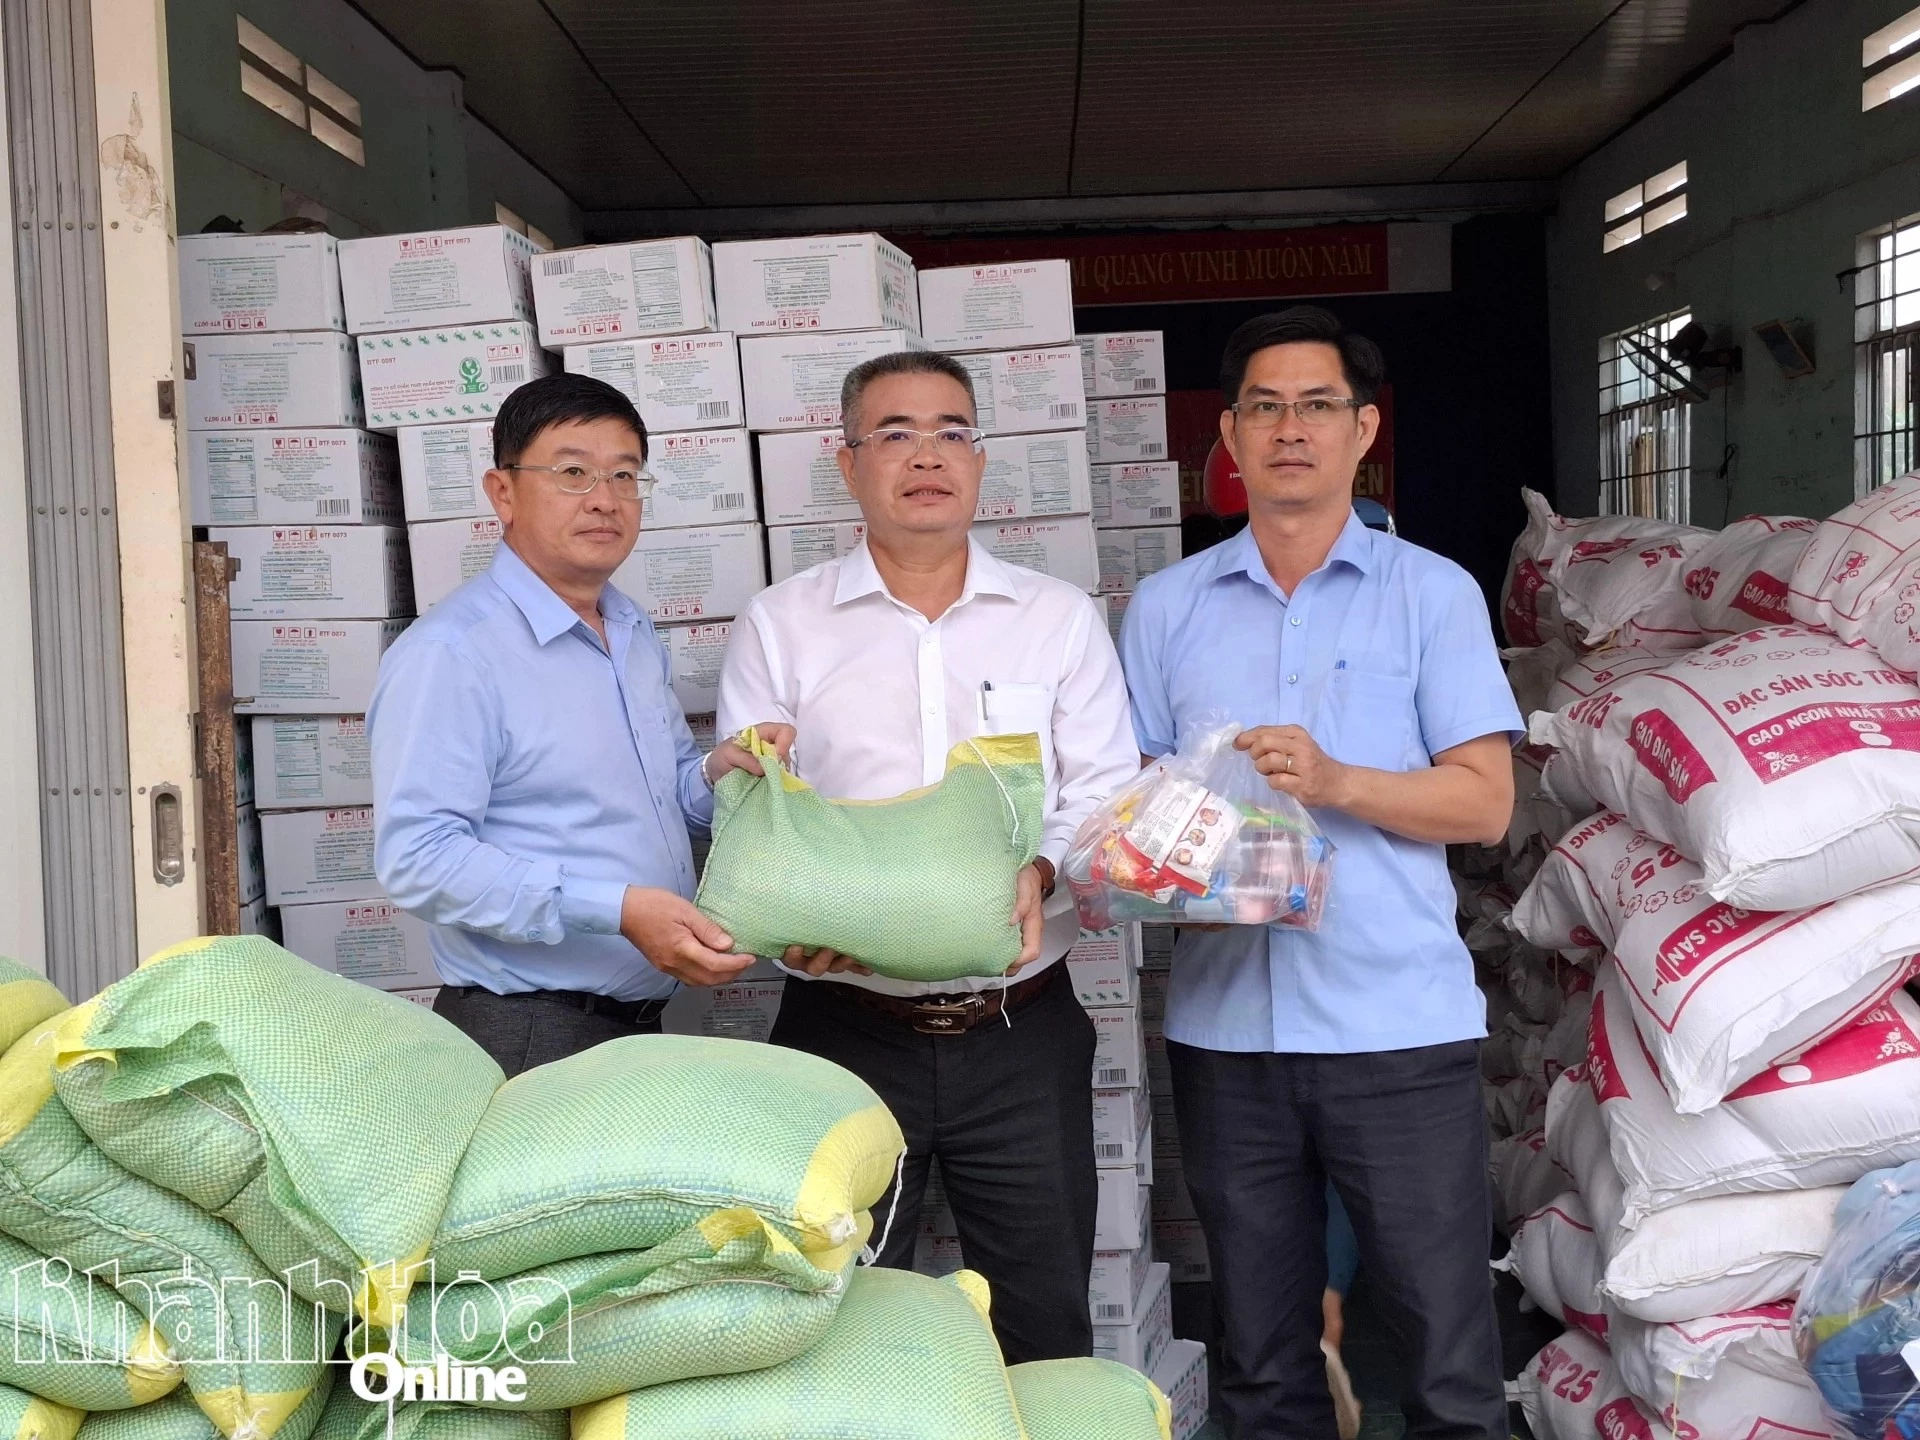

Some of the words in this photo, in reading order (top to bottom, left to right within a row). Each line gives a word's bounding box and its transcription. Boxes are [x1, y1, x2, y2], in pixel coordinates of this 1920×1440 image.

[1093, 253, 1175, 294] QUANG
[1180, 250, 1237, 284] VINH
[1244, 238, 1315, 279] MUÔN
[1319, 236, 1373, 277] NĂM
[1722, 689, 1769, 715] ĐẶC
[1768, 675, 1812, 696] SẢN
[1813, 670, 1863, 688] SÓC
[1748, 726, 1784, 747] GẠO
[1786, 707, 1833, 730] NGON
[1838, 704, 1886, 719] NHẤT
[1891, 706, 1920, 720] TH
[1635, 721, 1651, 750] GẠO
[1651, 737, 1671, 768] ĐẶC
[1668, 755, 1690, 789] SẢN
[1706, 907, 1750, 934] ĐẶC
[1667, 929, 1706, 967] SẢN
